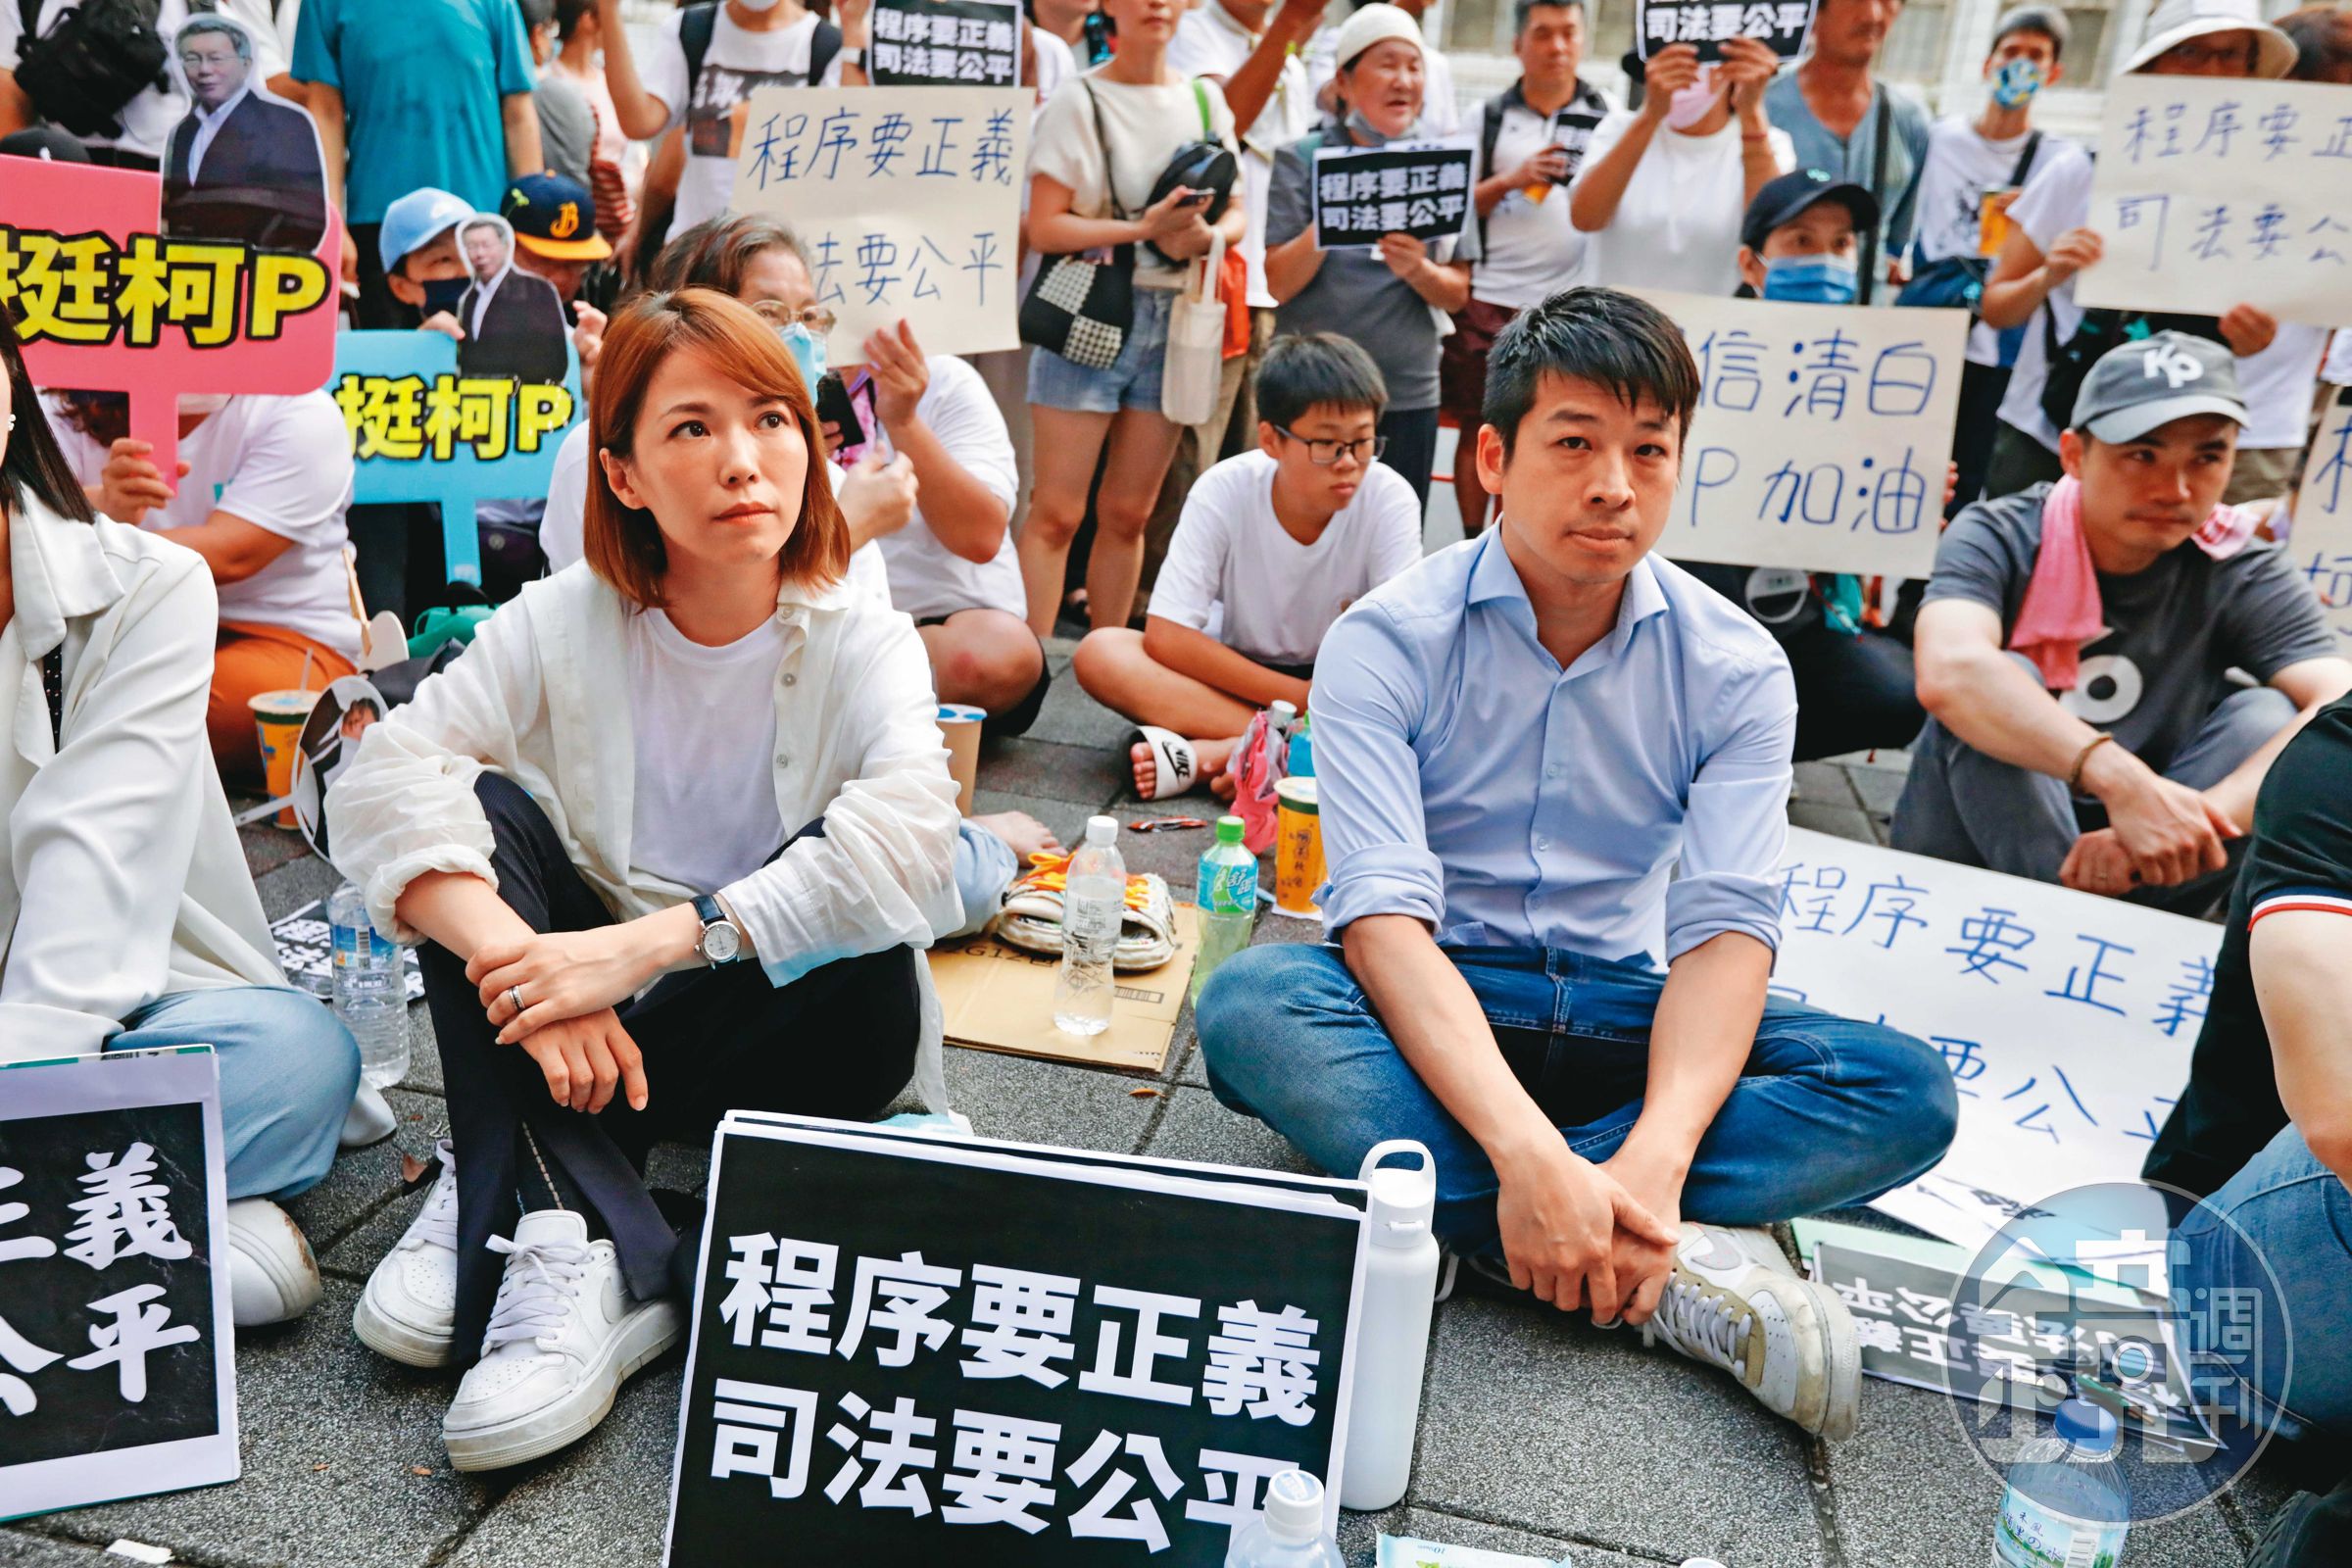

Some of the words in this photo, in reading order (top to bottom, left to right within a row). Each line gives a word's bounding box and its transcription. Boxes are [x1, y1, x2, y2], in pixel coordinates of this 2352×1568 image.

[874, 8, 1013, 52] 程序要正義
[1646, 3, 1809, 42] 司法要公平
[874, 42, 1013, 84] 司法要公平
[747, 106, 1013, 190] 程序要正義
[1320, 162, 1466, 203] 程序要正義
[1321, 194, 1465, 231] 司法要公平
[2116, 193, 2350, 271] 司法要公
[0, 226, 330, 347] 挺柯P
[1679, 328, 1937, 421] 信清白
[335, 374, 574, 462] 挺柯P
[718, 1232, 1321, 1428] 程序要正義
